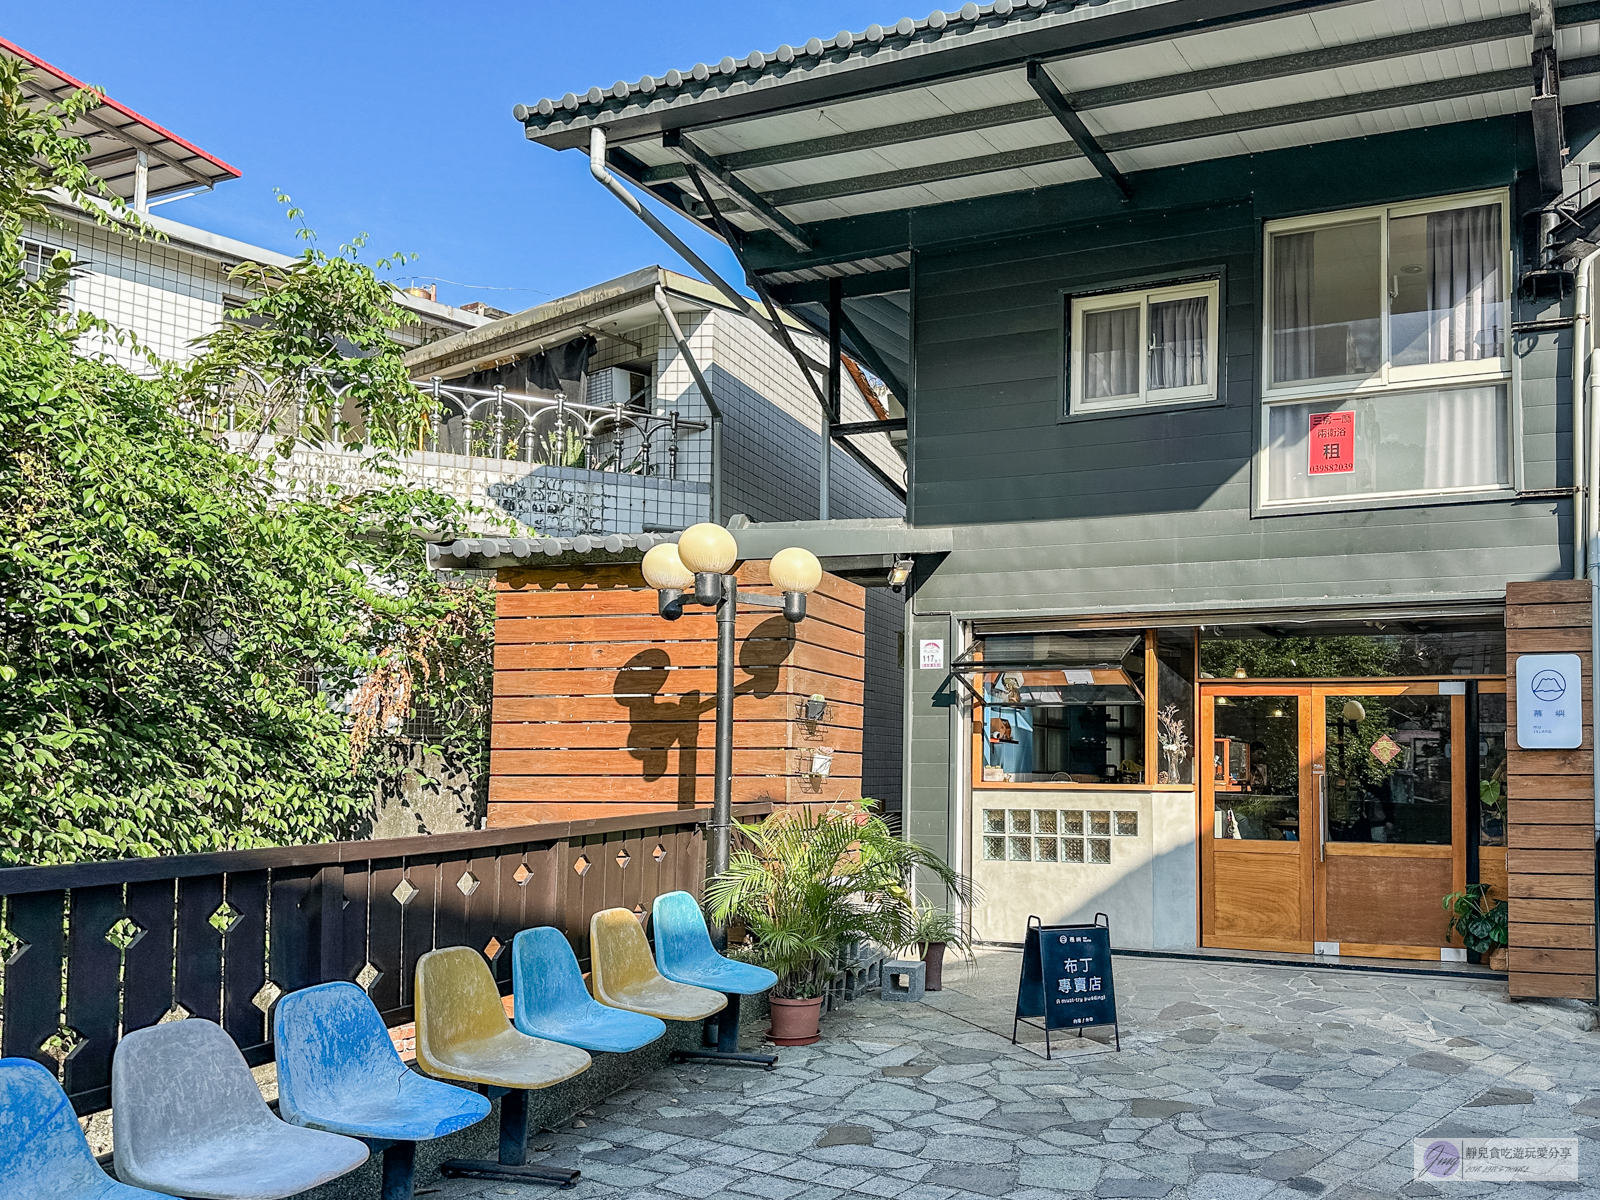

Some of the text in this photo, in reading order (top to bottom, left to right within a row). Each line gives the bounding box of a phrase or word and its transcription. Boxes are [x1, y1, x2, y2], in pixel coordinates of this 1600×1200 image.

[1323, 443, 1340, 460] 租
[1309, 463, 1353, 472] 039882039
[1064, 957, 1093, 974] 布丁
[1058, 976, 1101, 993] 專賣店
